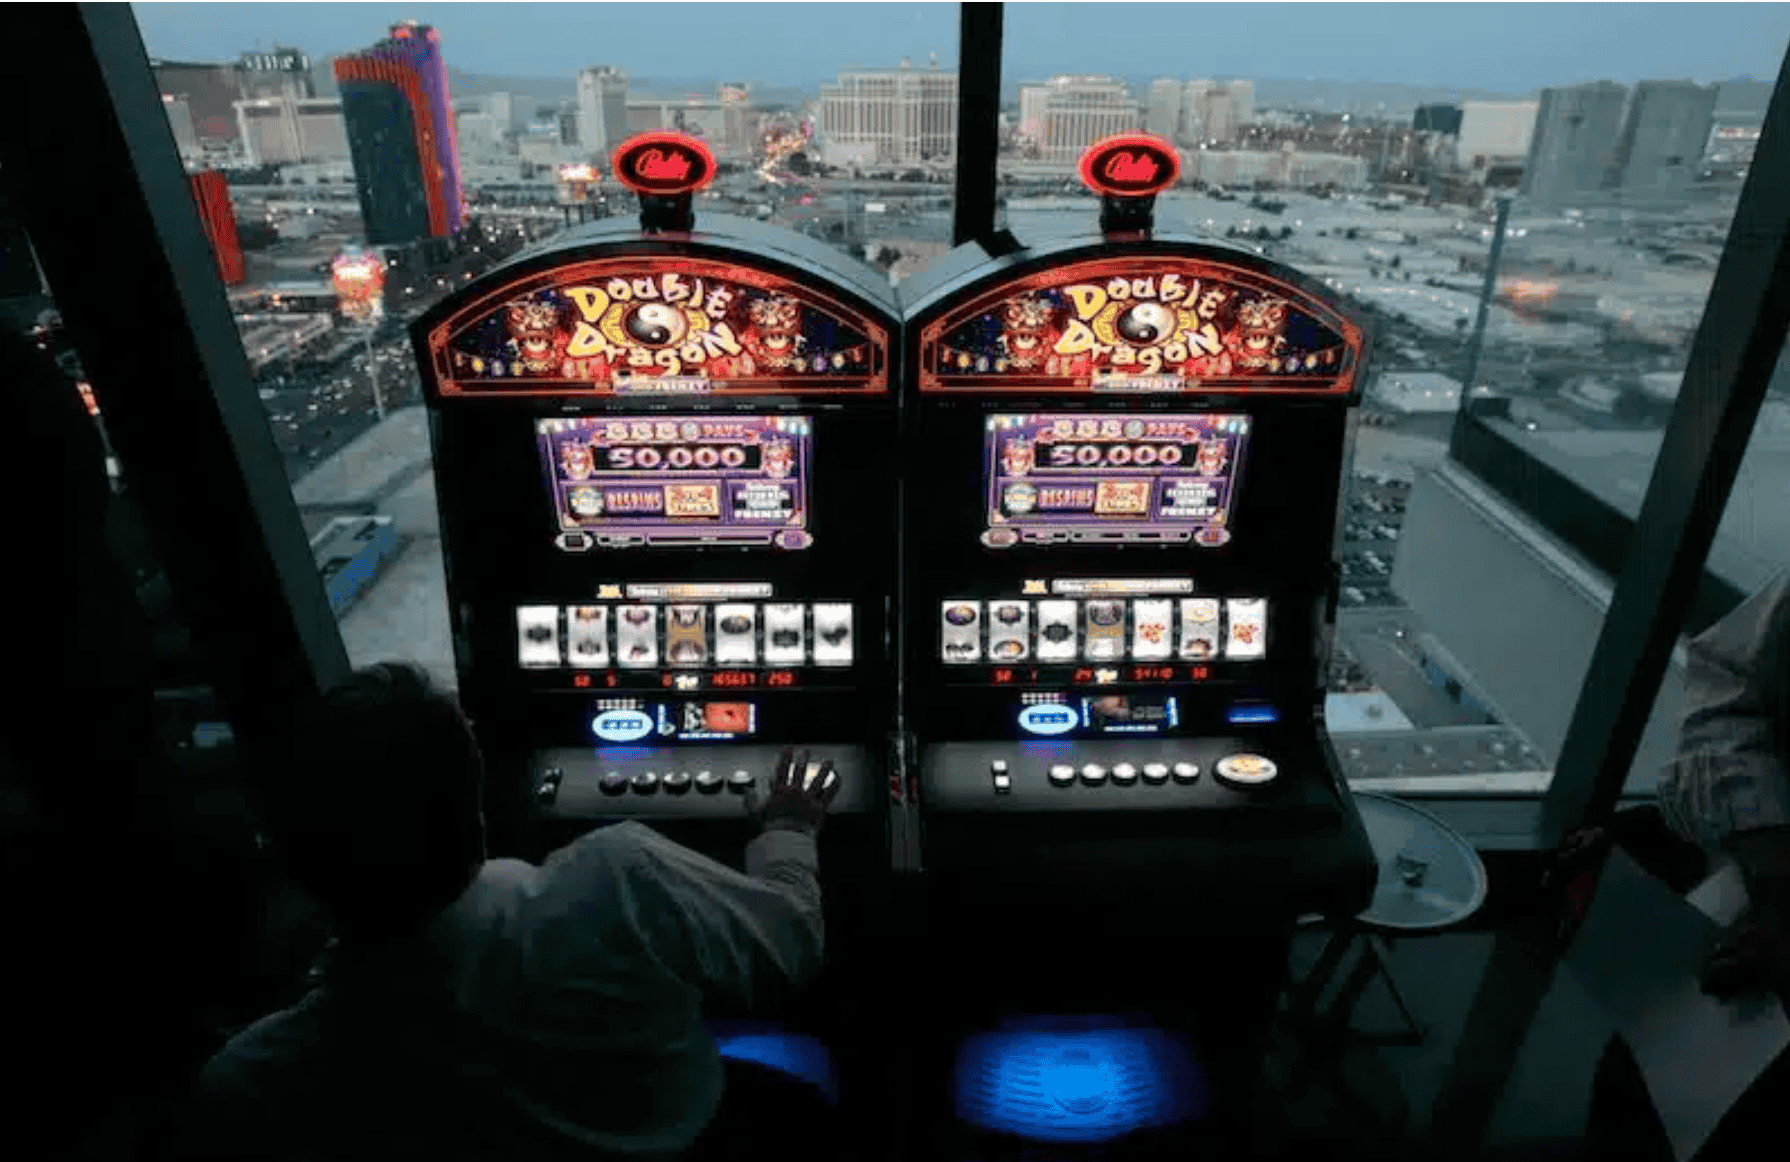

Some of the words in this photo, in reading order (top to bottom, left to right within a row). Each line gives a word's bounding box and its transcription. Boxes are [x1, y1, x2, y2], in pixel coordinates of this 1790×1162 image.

[701, 422, 744, 438] PAYS
[606, 446, 746, 471] 50,000
[1049, 444, 1182, 467] 50,000
